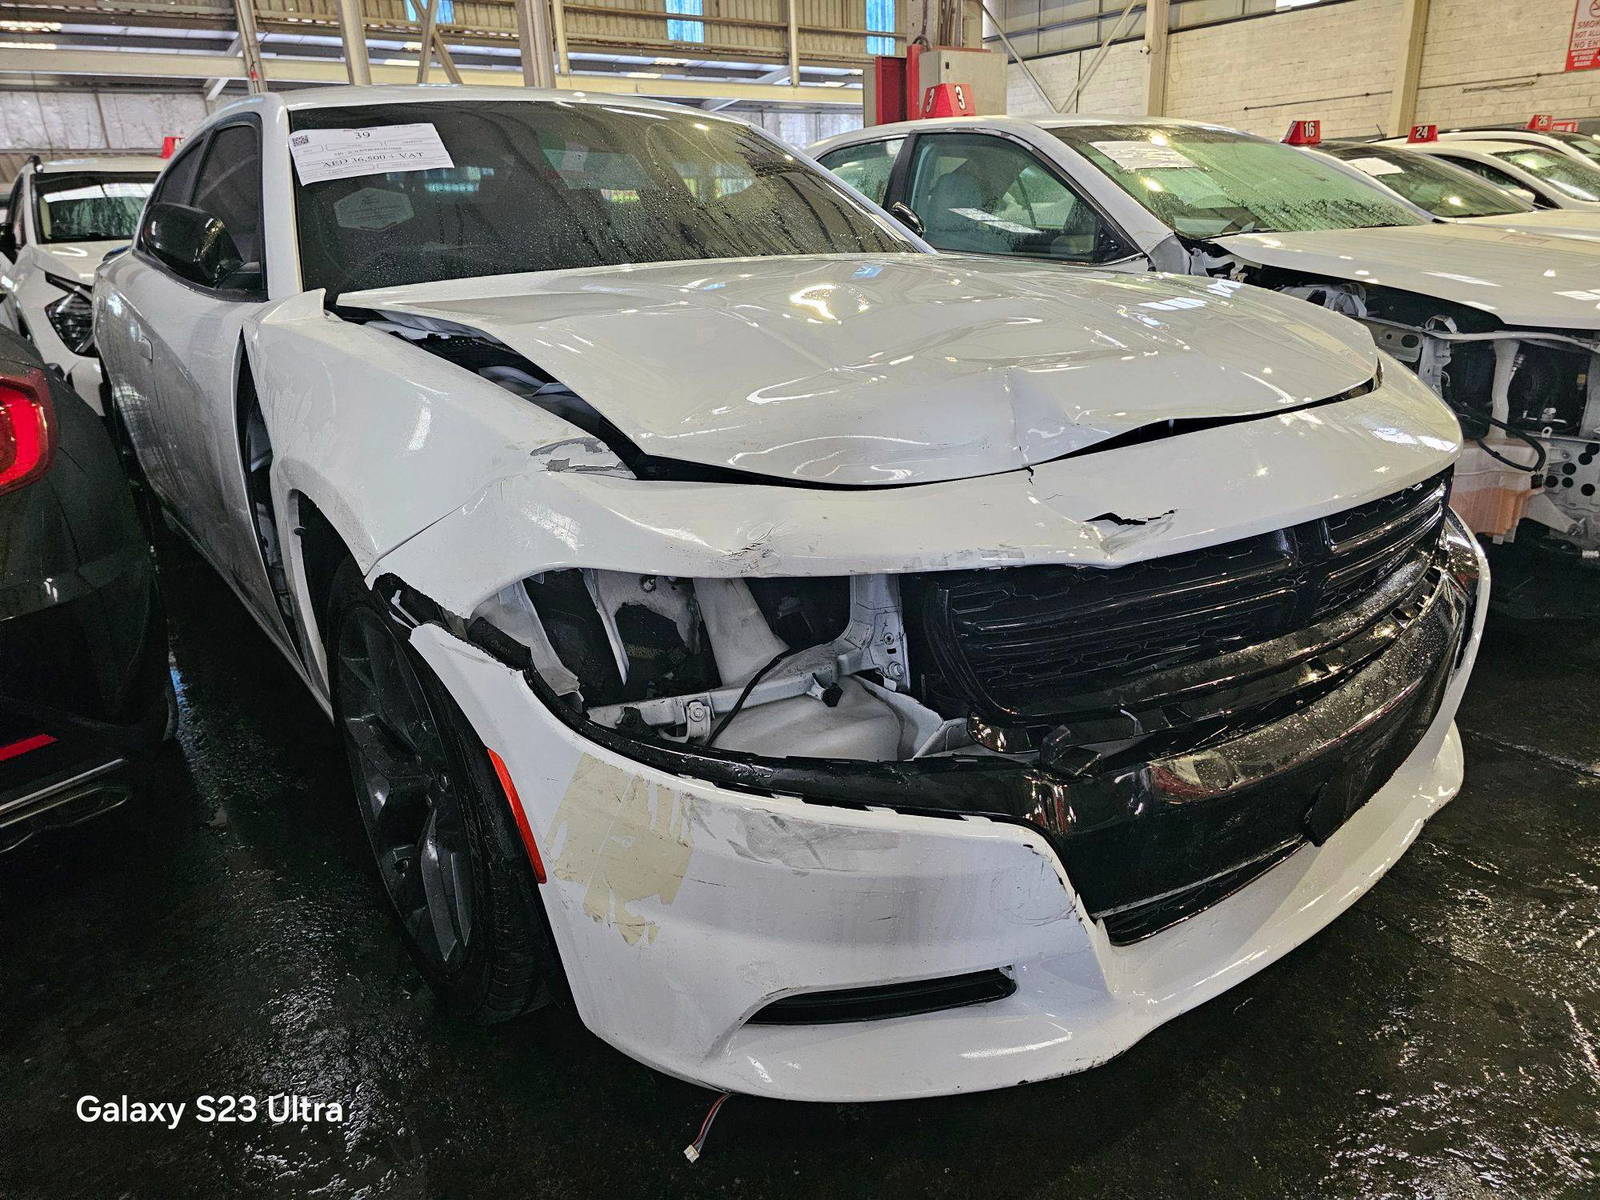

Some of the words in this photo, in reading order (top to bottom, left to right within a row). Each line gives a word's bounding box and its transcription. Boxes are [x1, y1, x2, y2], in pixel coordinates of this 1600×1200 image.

[926, 88, 935, 113] 3
[955, 85, 966, 110] 3
[355, 131, 371, 140] 39
[1304, 122, 1316, 138] 16
[1415, 126, 1428, 139] 24
[322, 158, 348, 168] AED
[399, 151, 425, 160] VAT
